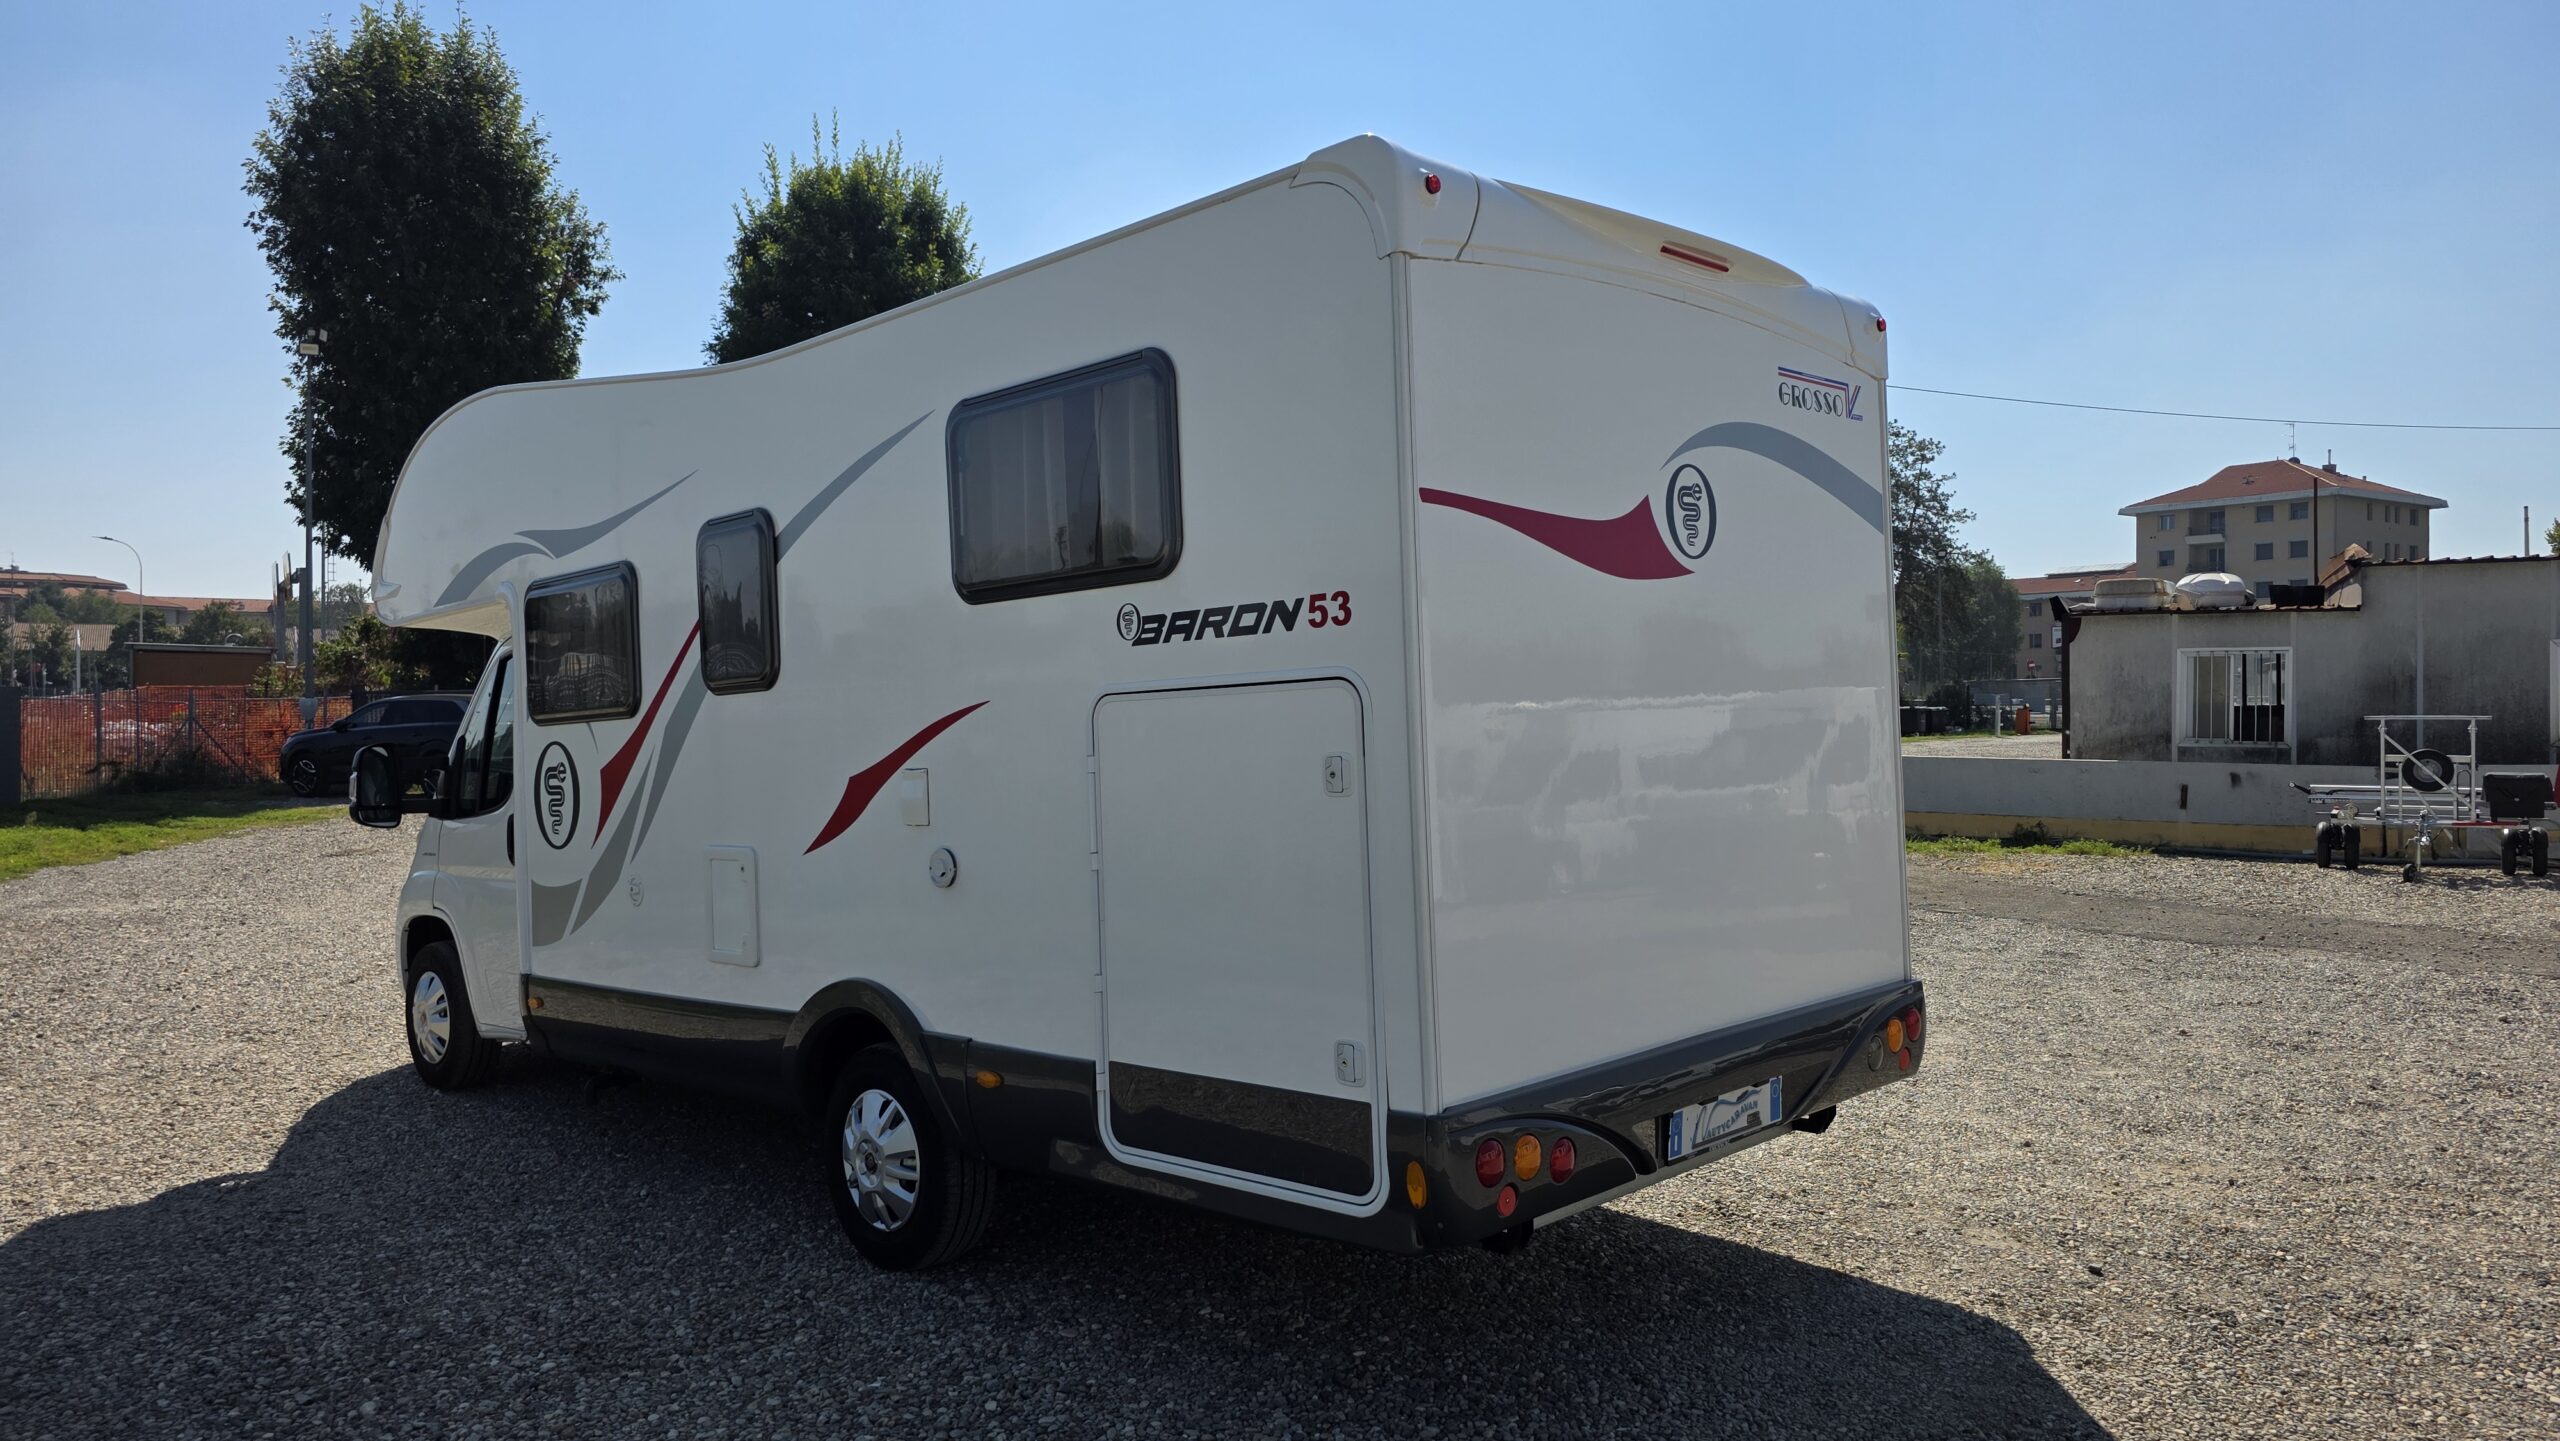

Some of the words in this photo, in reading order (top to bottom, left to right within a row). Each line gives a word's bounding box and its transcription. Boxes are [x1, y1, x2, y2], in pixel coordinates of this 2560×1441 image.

[1778, 382, 1844, 417] GROSSO
[1131, 597, 1305, 647] BARON
[1307, 590, 1352, 629] 53
